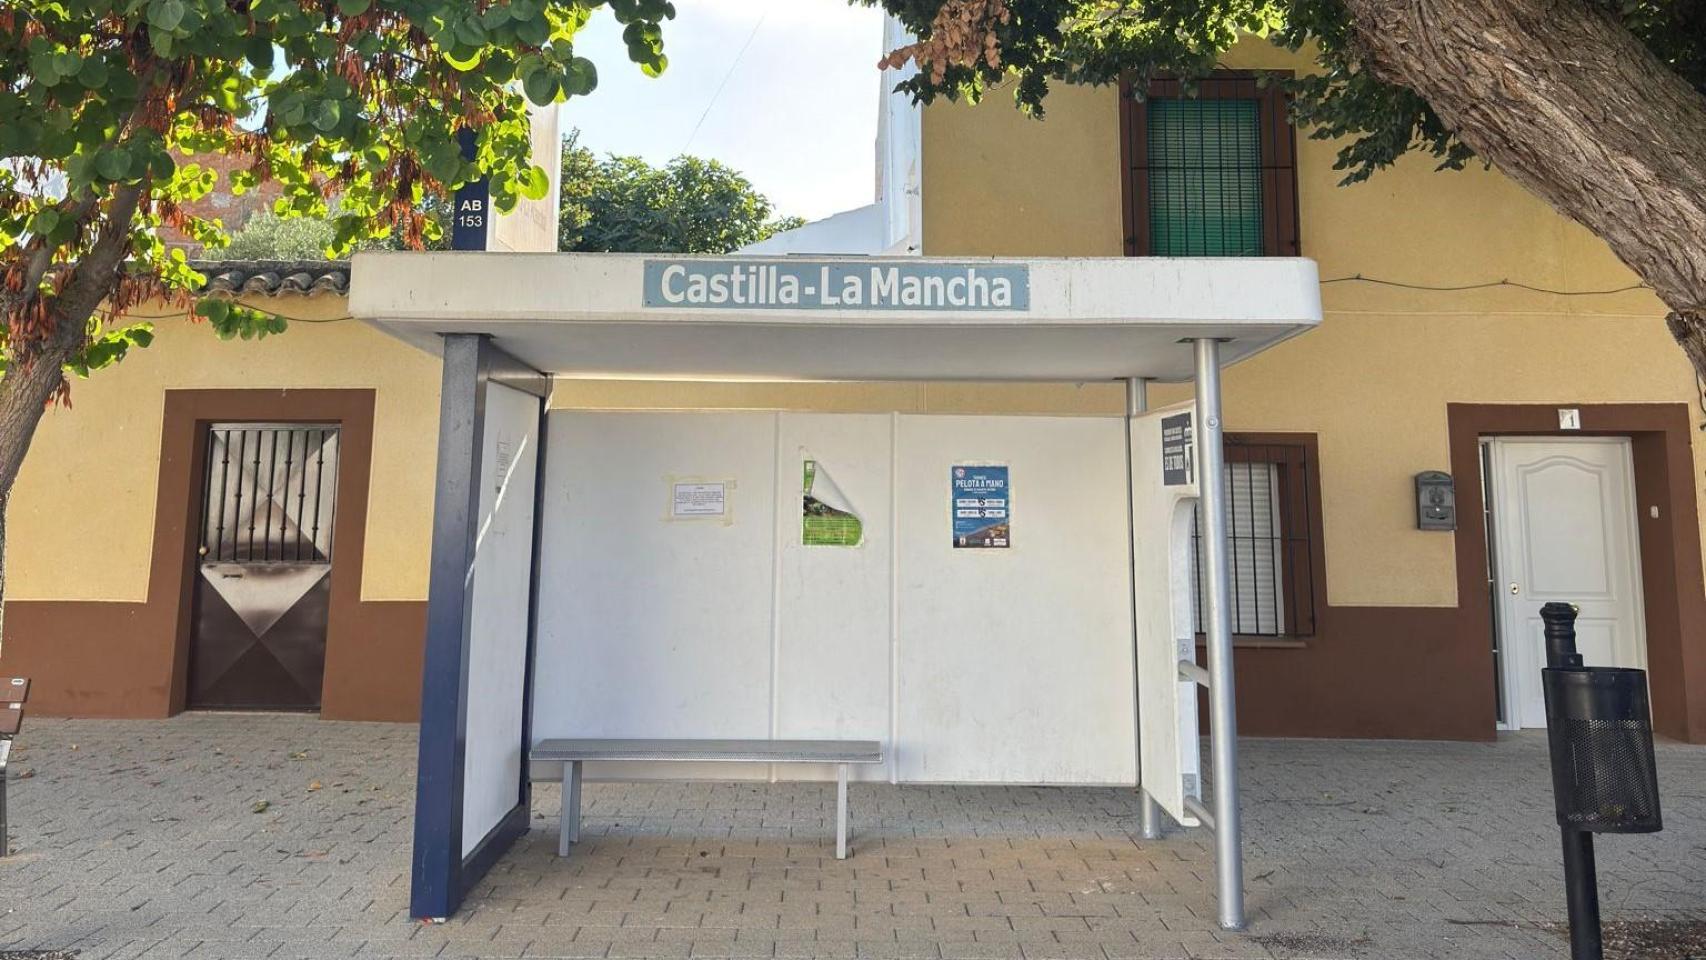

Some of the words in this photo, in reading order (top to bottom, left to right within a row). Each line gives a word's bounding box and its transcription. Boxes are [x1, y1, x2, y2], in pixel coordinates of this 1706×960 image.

[461, 199, 482, 211] AB
[459, 215, 482, 228] 153
[870, 267, 1012, 307] Mancha
[955, 480, 980, 488] PELOTA
[980, 480, 985, 488] A
[985, 480, 1004, 488] MANO
